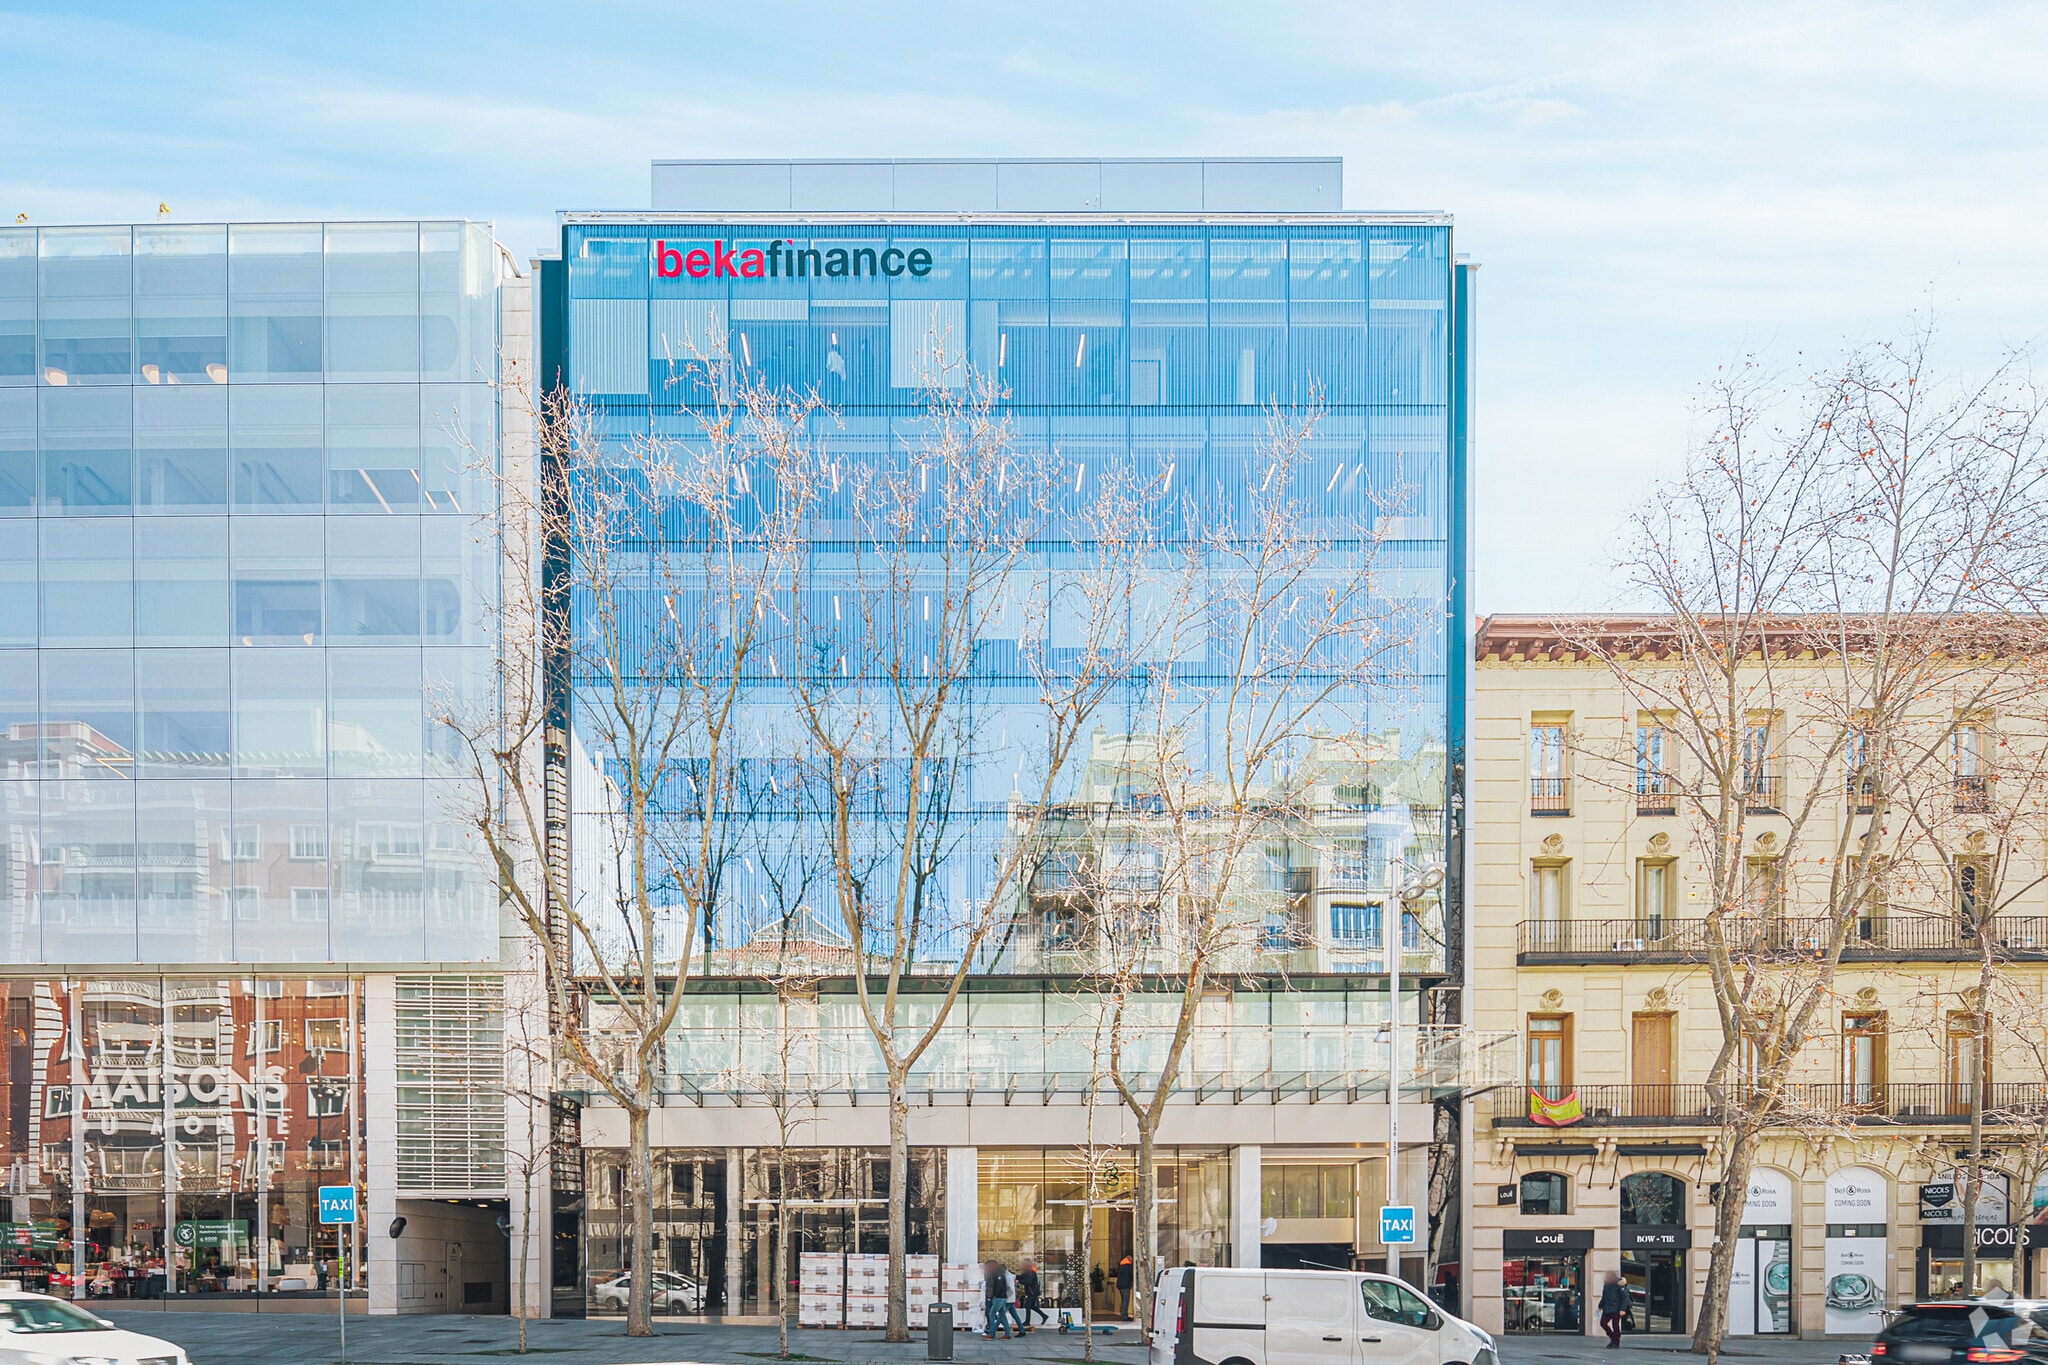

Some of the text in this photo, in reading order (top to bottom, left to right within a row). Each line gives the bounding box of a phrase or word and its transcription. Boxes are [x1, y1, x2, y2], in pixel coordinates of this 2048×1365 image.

[657, 240, 932, 277] bekafinance
[74, 1066, 288, 1103] MAISONS
[322, 1199, 352, 1210] TAXI
[1384, 1219, 1412, 1231] TAXI
[1967, 1228, 2030, 1245] ICOL'S
